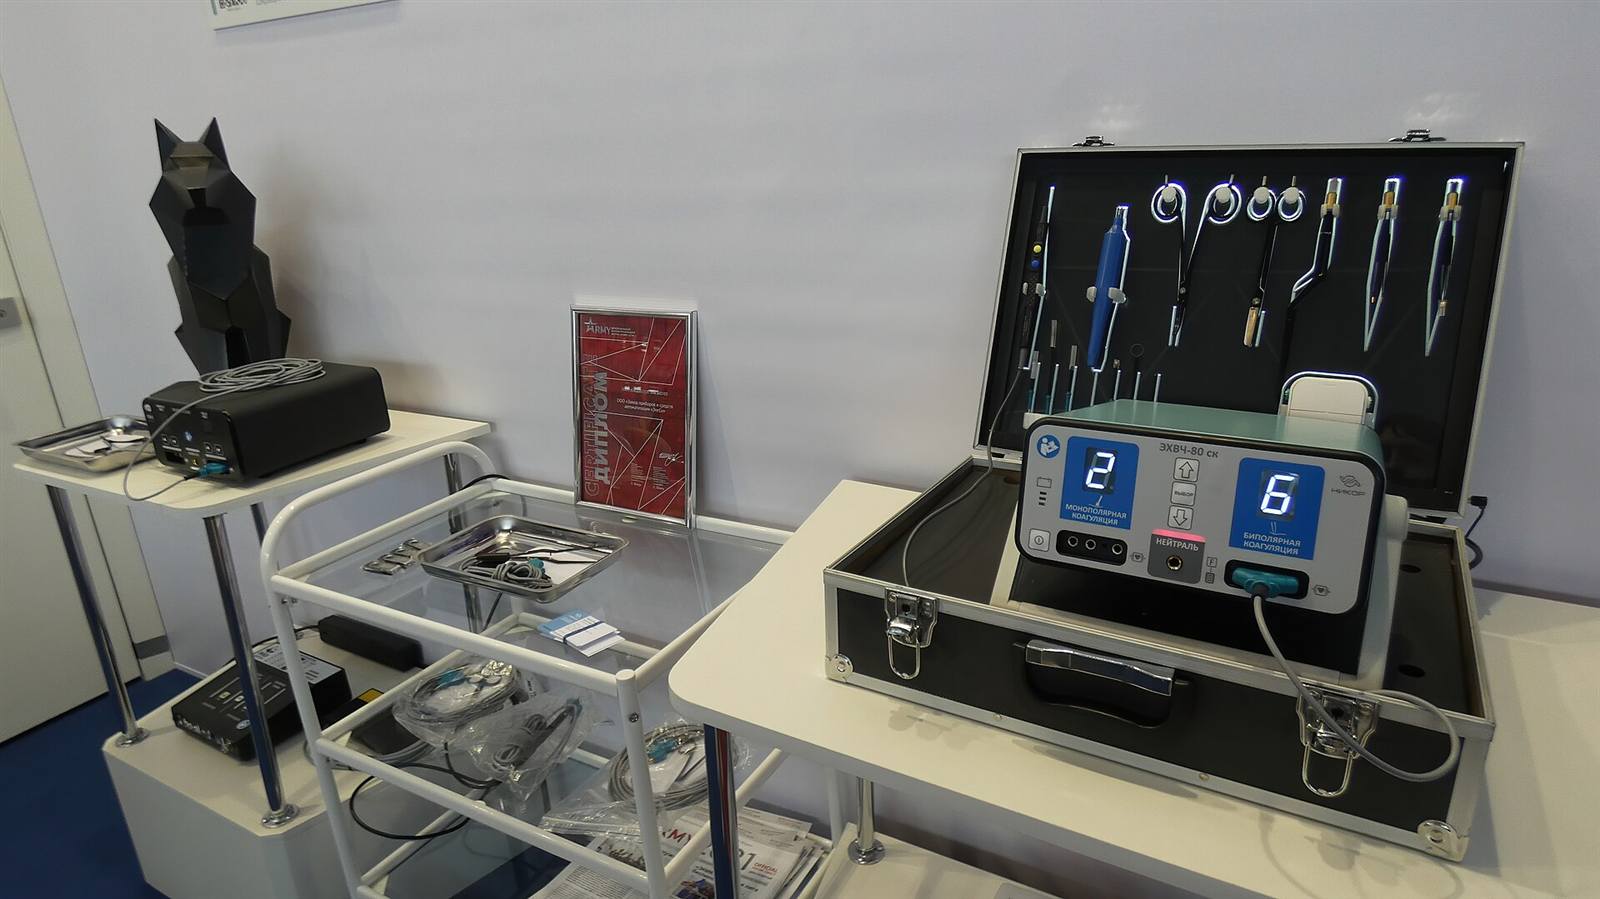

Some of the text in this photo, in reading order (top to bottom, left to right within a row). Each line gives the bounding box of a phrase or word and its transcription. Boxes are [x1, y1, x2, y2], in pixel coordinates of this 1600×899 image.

[593, 371, 611, 485] ДИПЛОМ
[1159, 442, 1204, 458] ЭХВЧ-80
[1085, 452, 1116, 490] 2
[1259, 474, 1296, 515] 6
[1065, 503, 1128, 519] МОНОПОЛЯРНАЯ
[1071, 512, 1119, 526] КОАГУЛЯЦИЯ
[1155, 537, 1200, 552] НЕЙТРАЛЬ
[1243, 531, 1301, 547] БИПОЛЯРНАЯ
[1243, 540, 1300, 556] КОАГУЛЯЦИЯ
